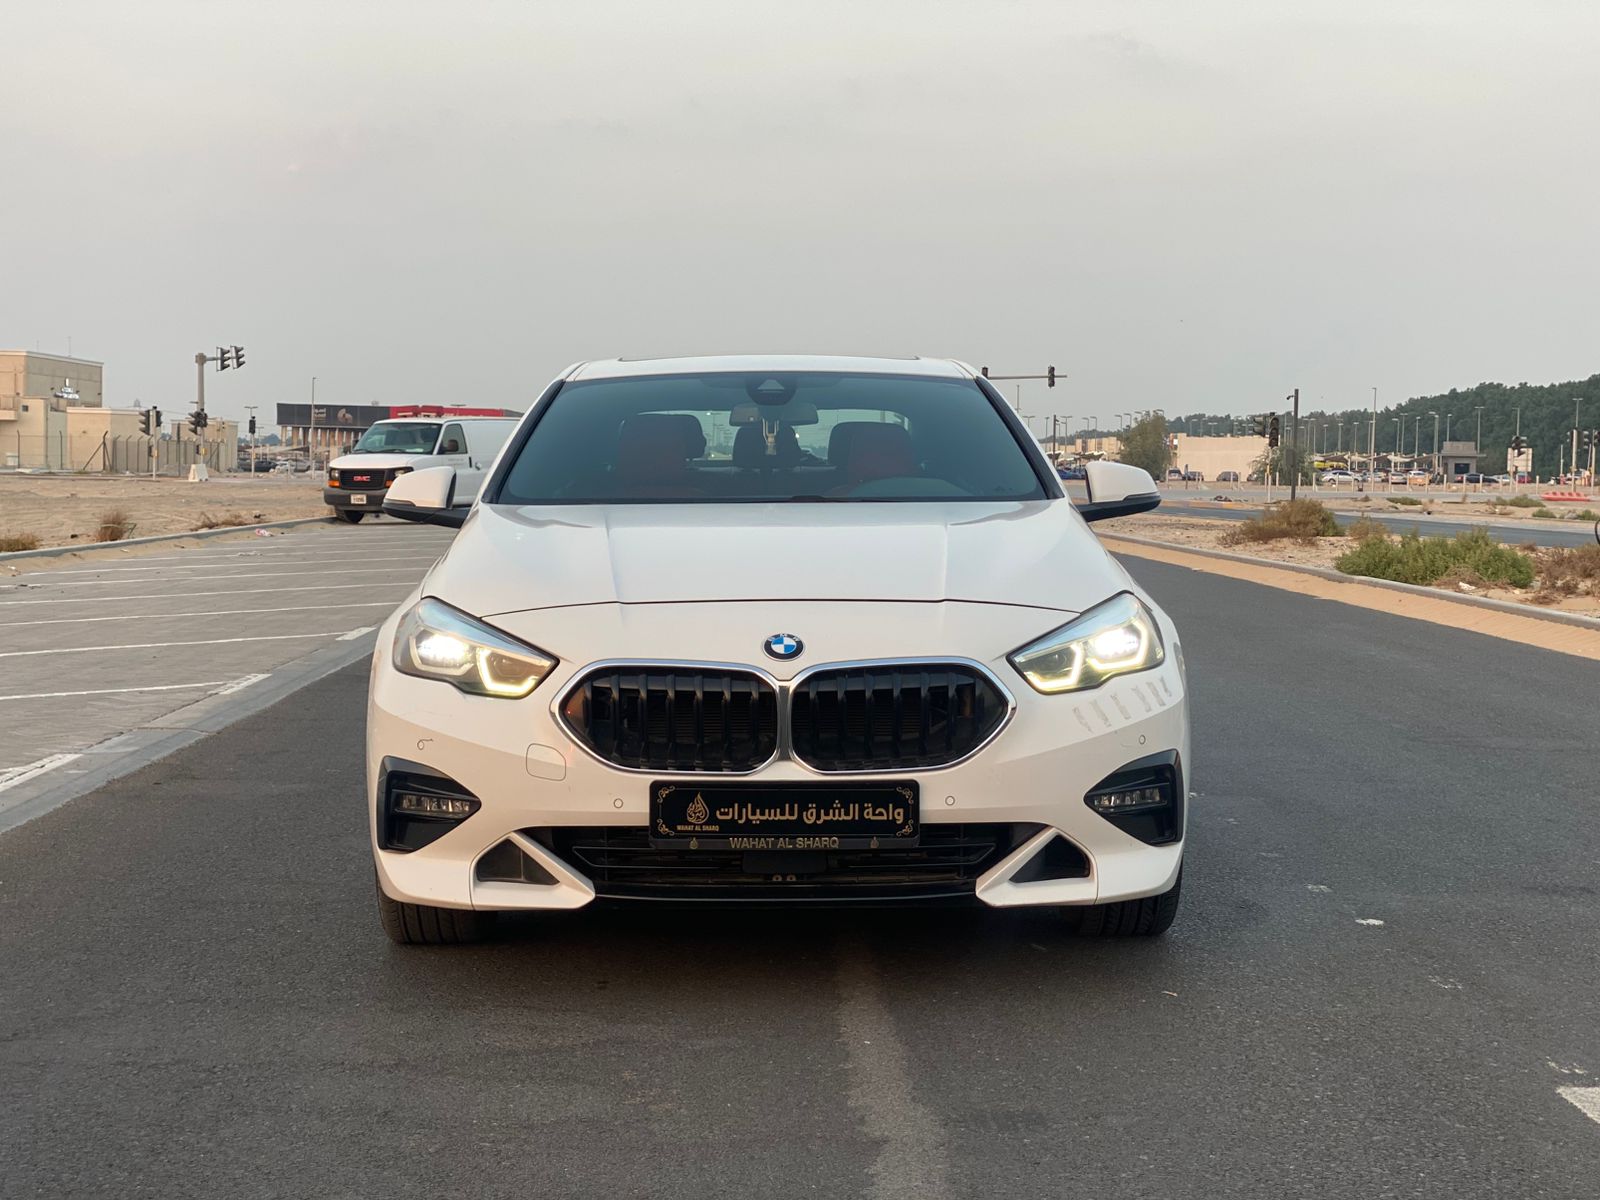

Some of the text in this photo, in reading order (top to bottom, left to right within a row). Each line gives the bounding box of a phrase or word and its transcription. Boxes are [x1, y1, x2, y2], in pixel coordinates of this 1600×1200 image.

[715, 803, 798, 824] للسيارات
[802, 800, 859, 824] الشرق
[863, 803, 905, 824] واحة
[729, 837, 840, 849] WAHAT AL SHARQ
